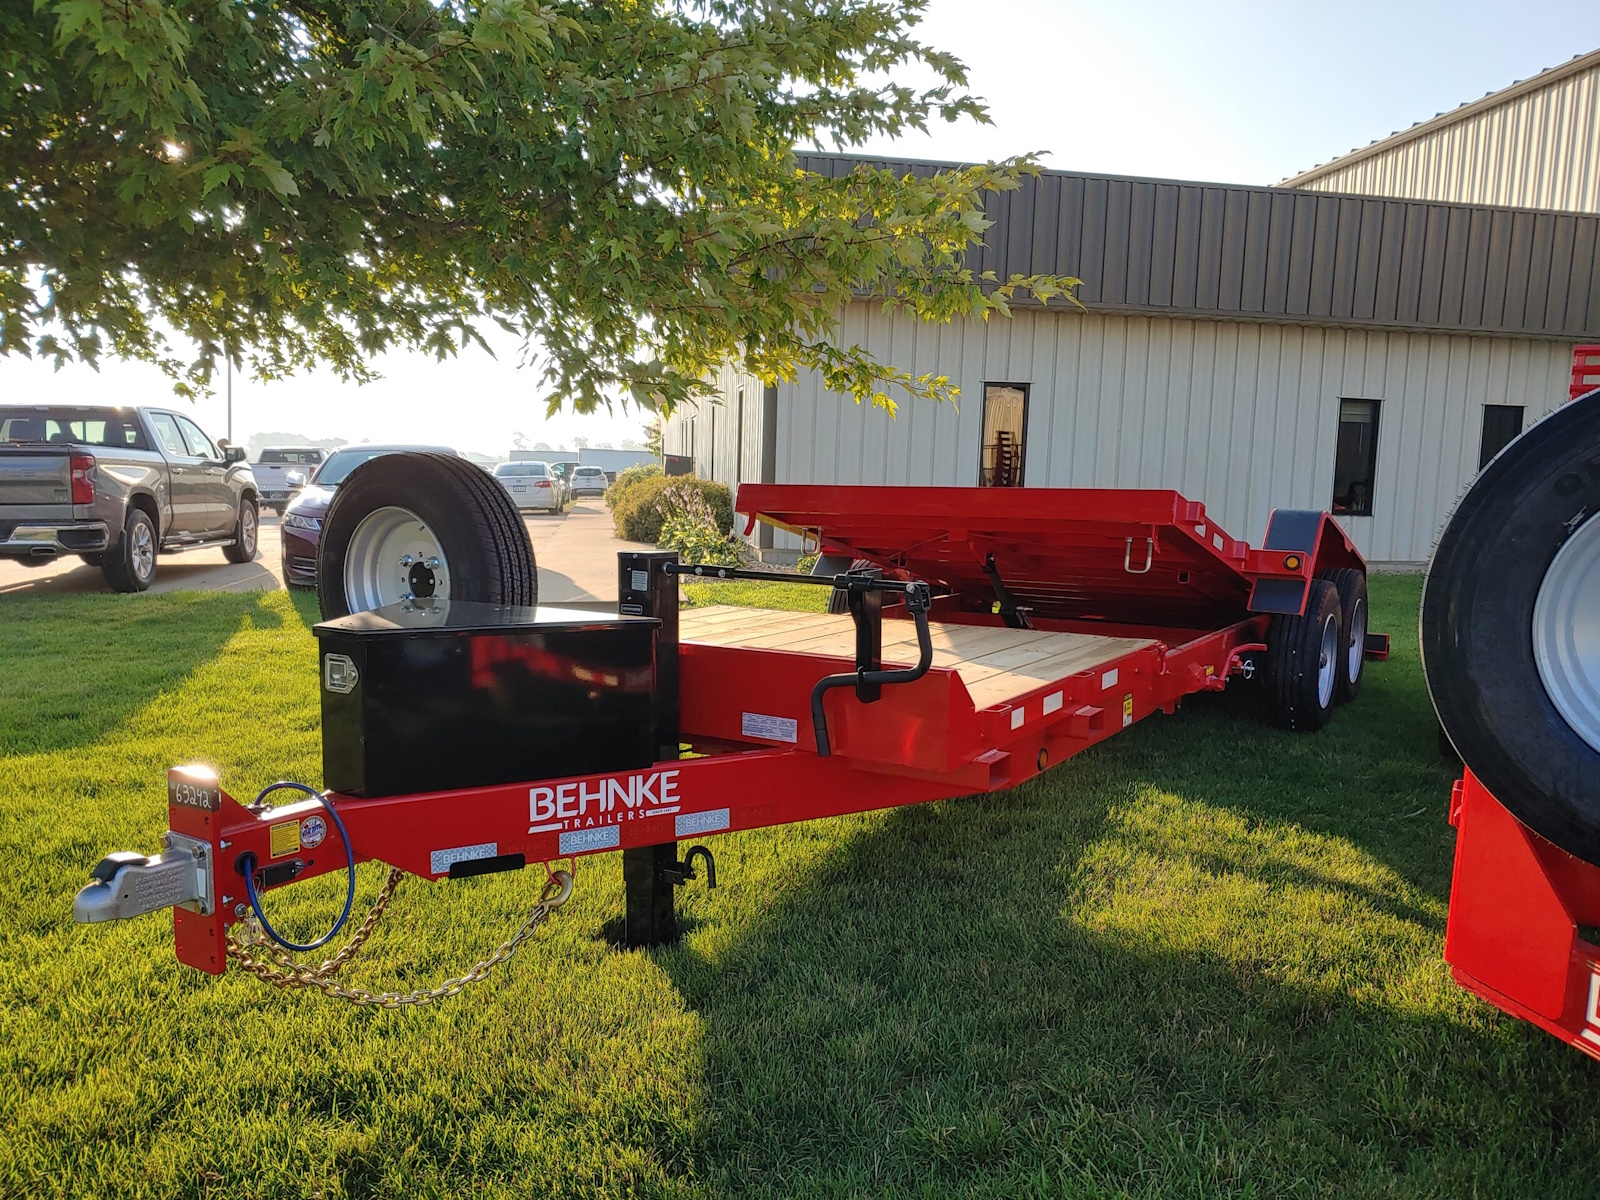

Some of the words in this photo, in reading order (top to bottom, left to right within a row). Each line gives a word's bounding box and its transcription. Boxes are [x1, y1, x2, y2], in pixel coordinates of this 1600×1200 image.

[175, 783, 212, 809] 63242
[529, 770, 681, 822] BEHNKE
[562, 808, 646, 830] TRAILERS
[685, 814, 720, 828] BEHNKE
[570, 831, 609, 846] BEHNKE
[443, 849, 486, 864] BEHNKE
